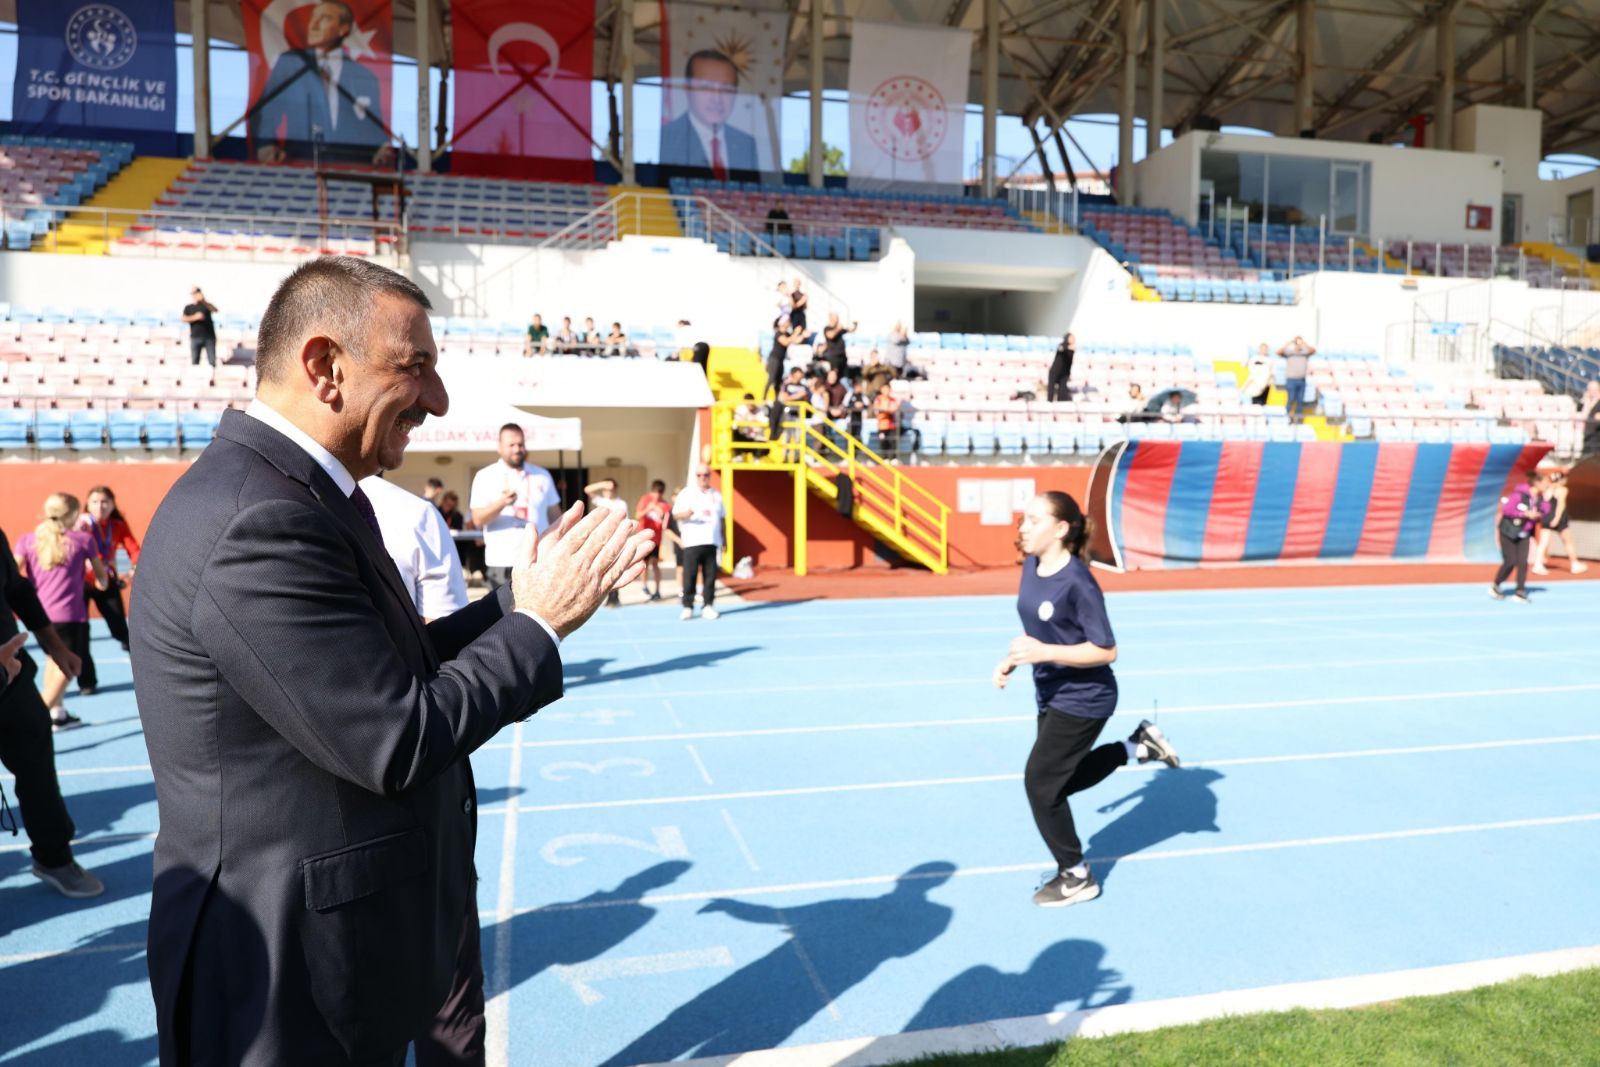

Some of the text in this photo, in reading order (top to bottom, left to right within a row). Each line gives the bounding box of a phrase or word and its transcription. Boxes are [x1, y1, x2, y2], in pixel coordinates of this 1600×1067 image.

[30, 69, 166, 94] T.C. GENÇLİK VE
[27, 86, 166, 112] SPOR BAKANLIĞI
[540, 757, 656, 782] 3
[539, 825, 690, 867] 2
[549, 945, 735, 1006] 1
